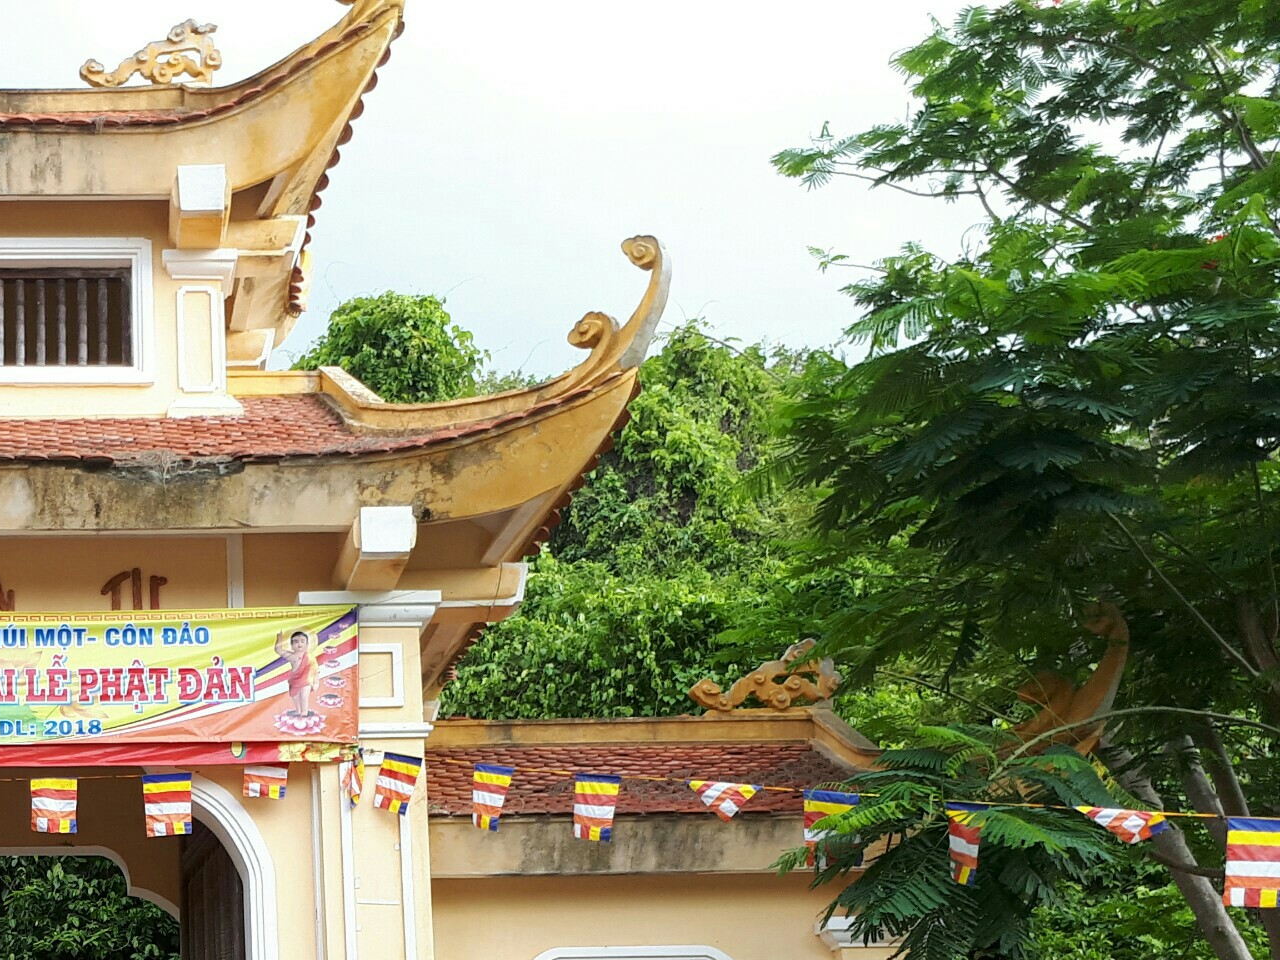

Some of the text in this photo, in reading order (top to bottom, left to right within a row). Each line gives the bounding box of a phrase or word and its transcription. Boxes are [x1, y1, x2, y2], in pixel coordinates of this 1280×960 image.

[105, 624, 154, 646] CÔN
[161, 622, 210, 646] ĐẢO
[24, 653, 69, 703] LỄ
[77, 659, 169, 711] PHẬT
[177, 655, 253, 702] ĐẢN
[0, 720, 36, 736] DL:
[43, 719, 102, 736] 2018
